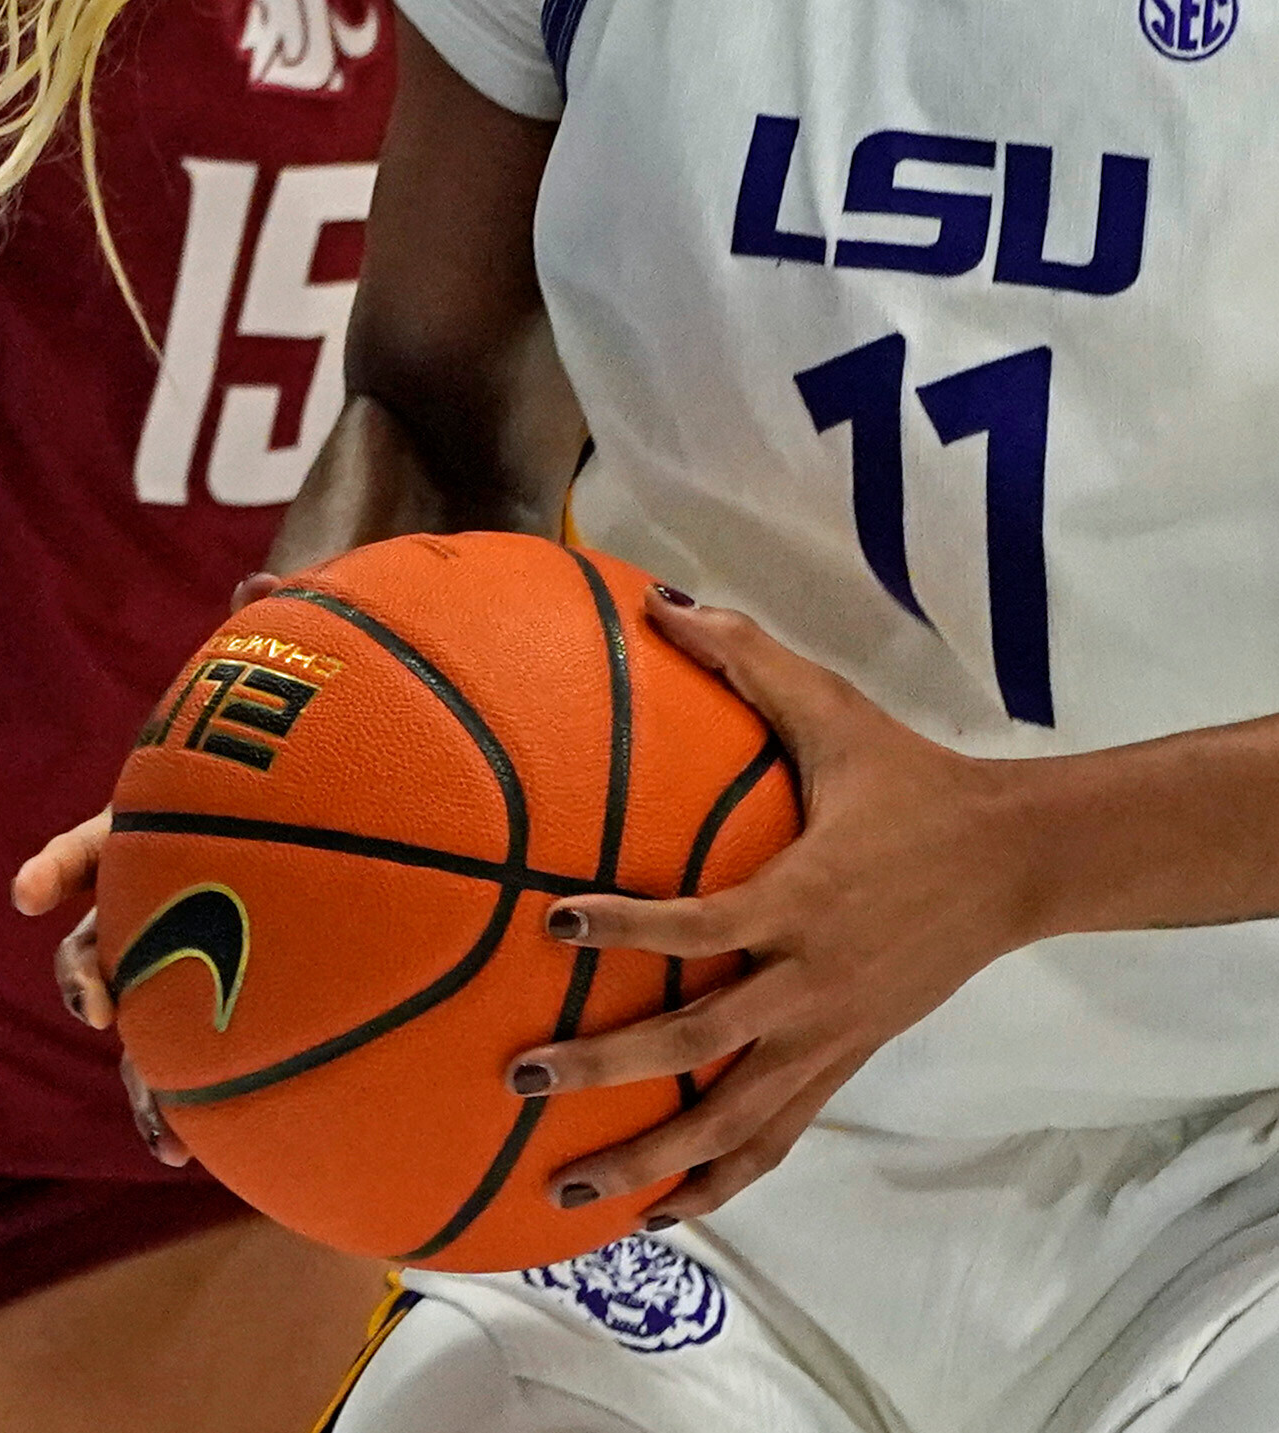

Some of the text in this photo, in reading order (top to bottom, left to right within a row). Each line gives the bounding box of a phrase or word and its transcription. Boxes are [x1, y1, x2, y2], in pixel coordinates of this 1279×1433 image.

[134, 156, 379, 506] 15
[730, 114, 1150, 296] LSU
[793, 331, 1055, 728] 11
[135, 656, 322, 772] ELI
